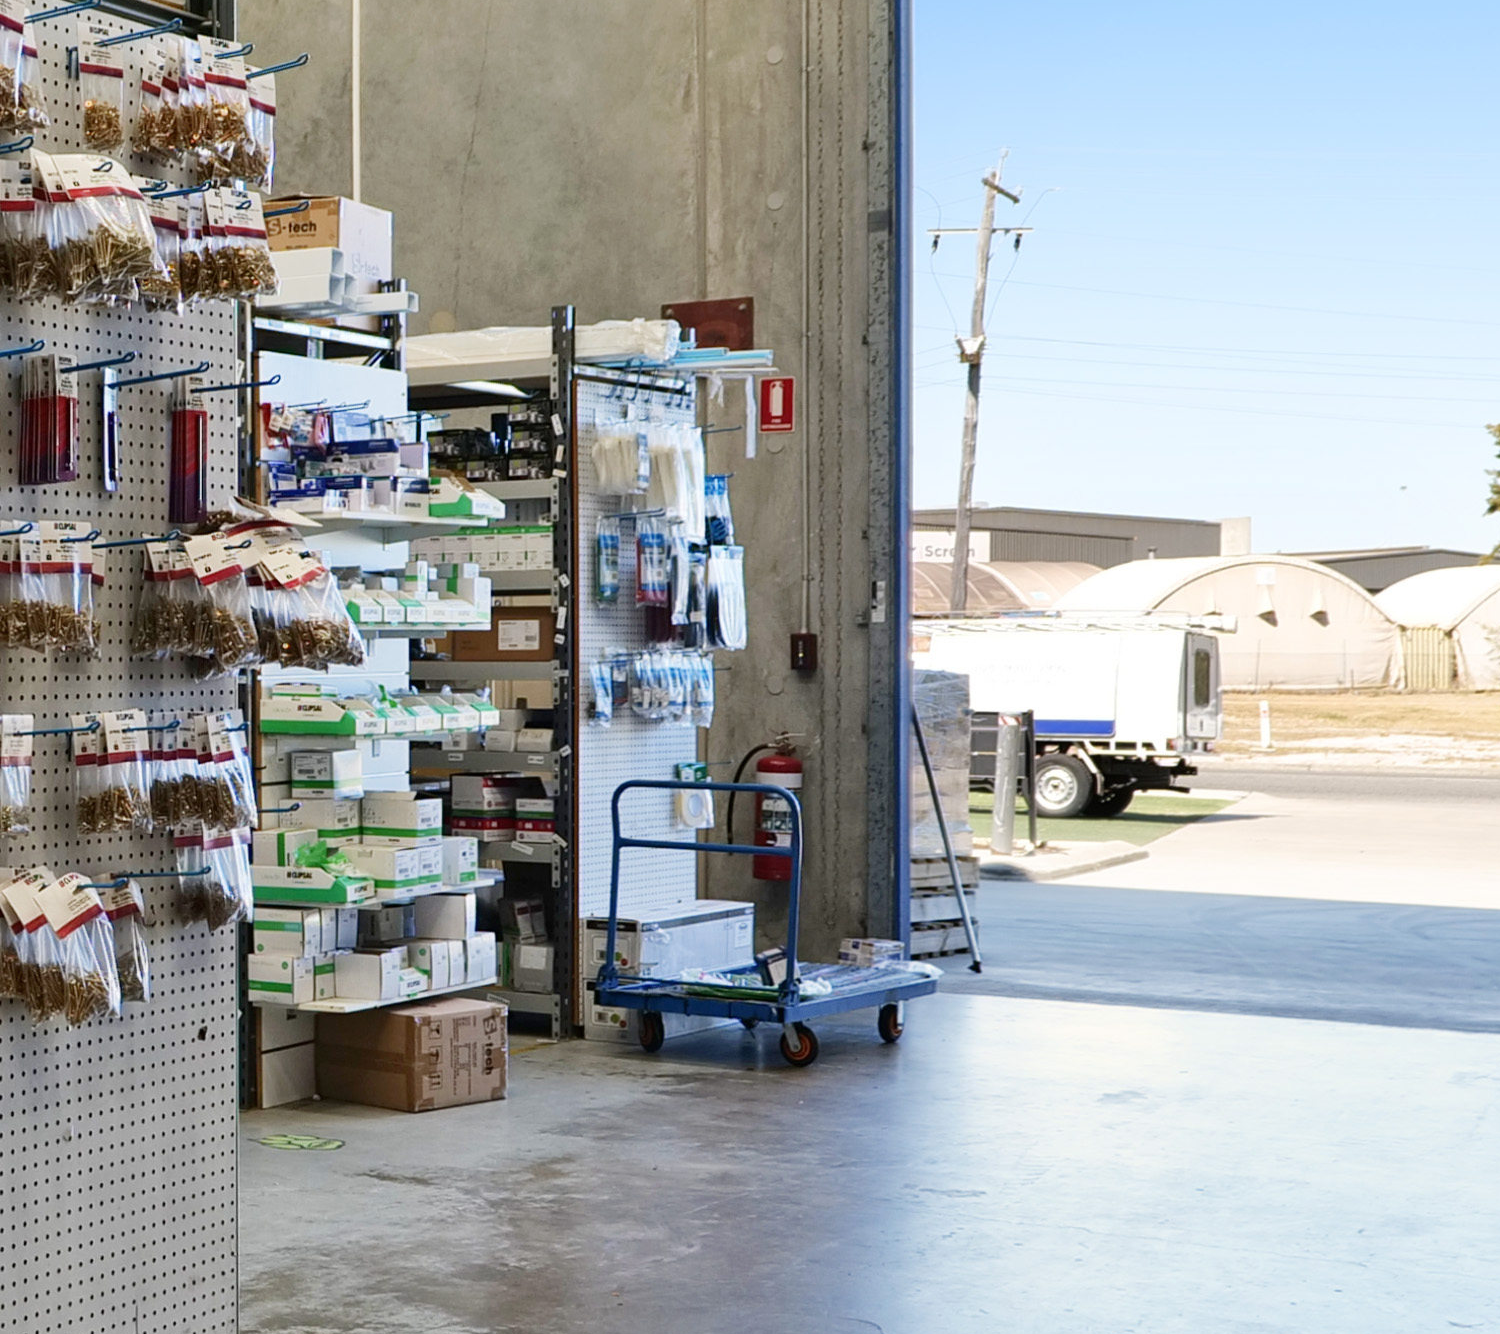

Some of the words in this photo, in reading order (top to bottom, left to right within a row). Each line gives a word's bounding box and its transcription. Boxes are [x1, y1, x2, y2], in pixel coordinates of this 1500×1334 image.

[924, 545, 976, 558] Scren
[297, 703, 323, 713] CLIPSAL
[286, 870, 314, 880] CLIPSAL
